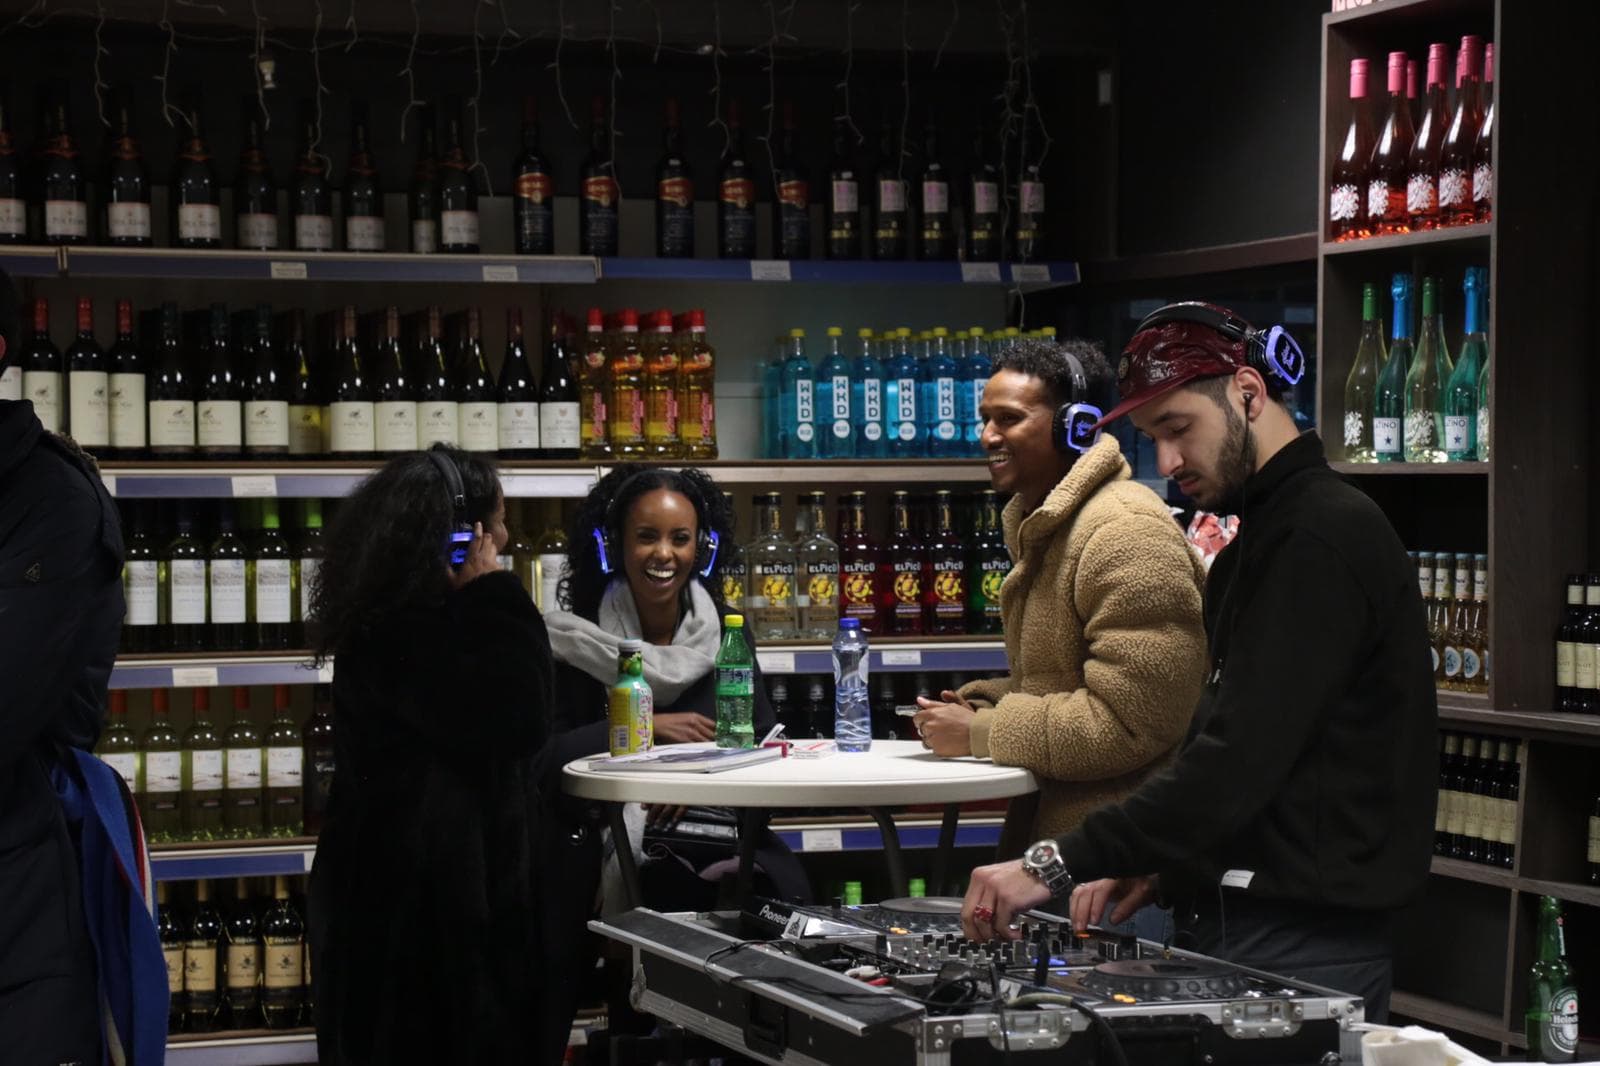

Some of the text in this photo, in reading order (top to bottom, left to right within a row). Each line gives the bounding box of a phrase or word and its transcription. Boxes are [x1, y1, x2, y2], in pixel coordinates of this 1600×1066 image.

[800, 382, 811, 418] WKD
[835, 379, 847, 415] WKD
[868, 381, 878, 417] WKD
[901, 382, 912, 417] WKD
[941, 380, 951, 416] WKD
[758, 904, 791, 926] Pioneer
